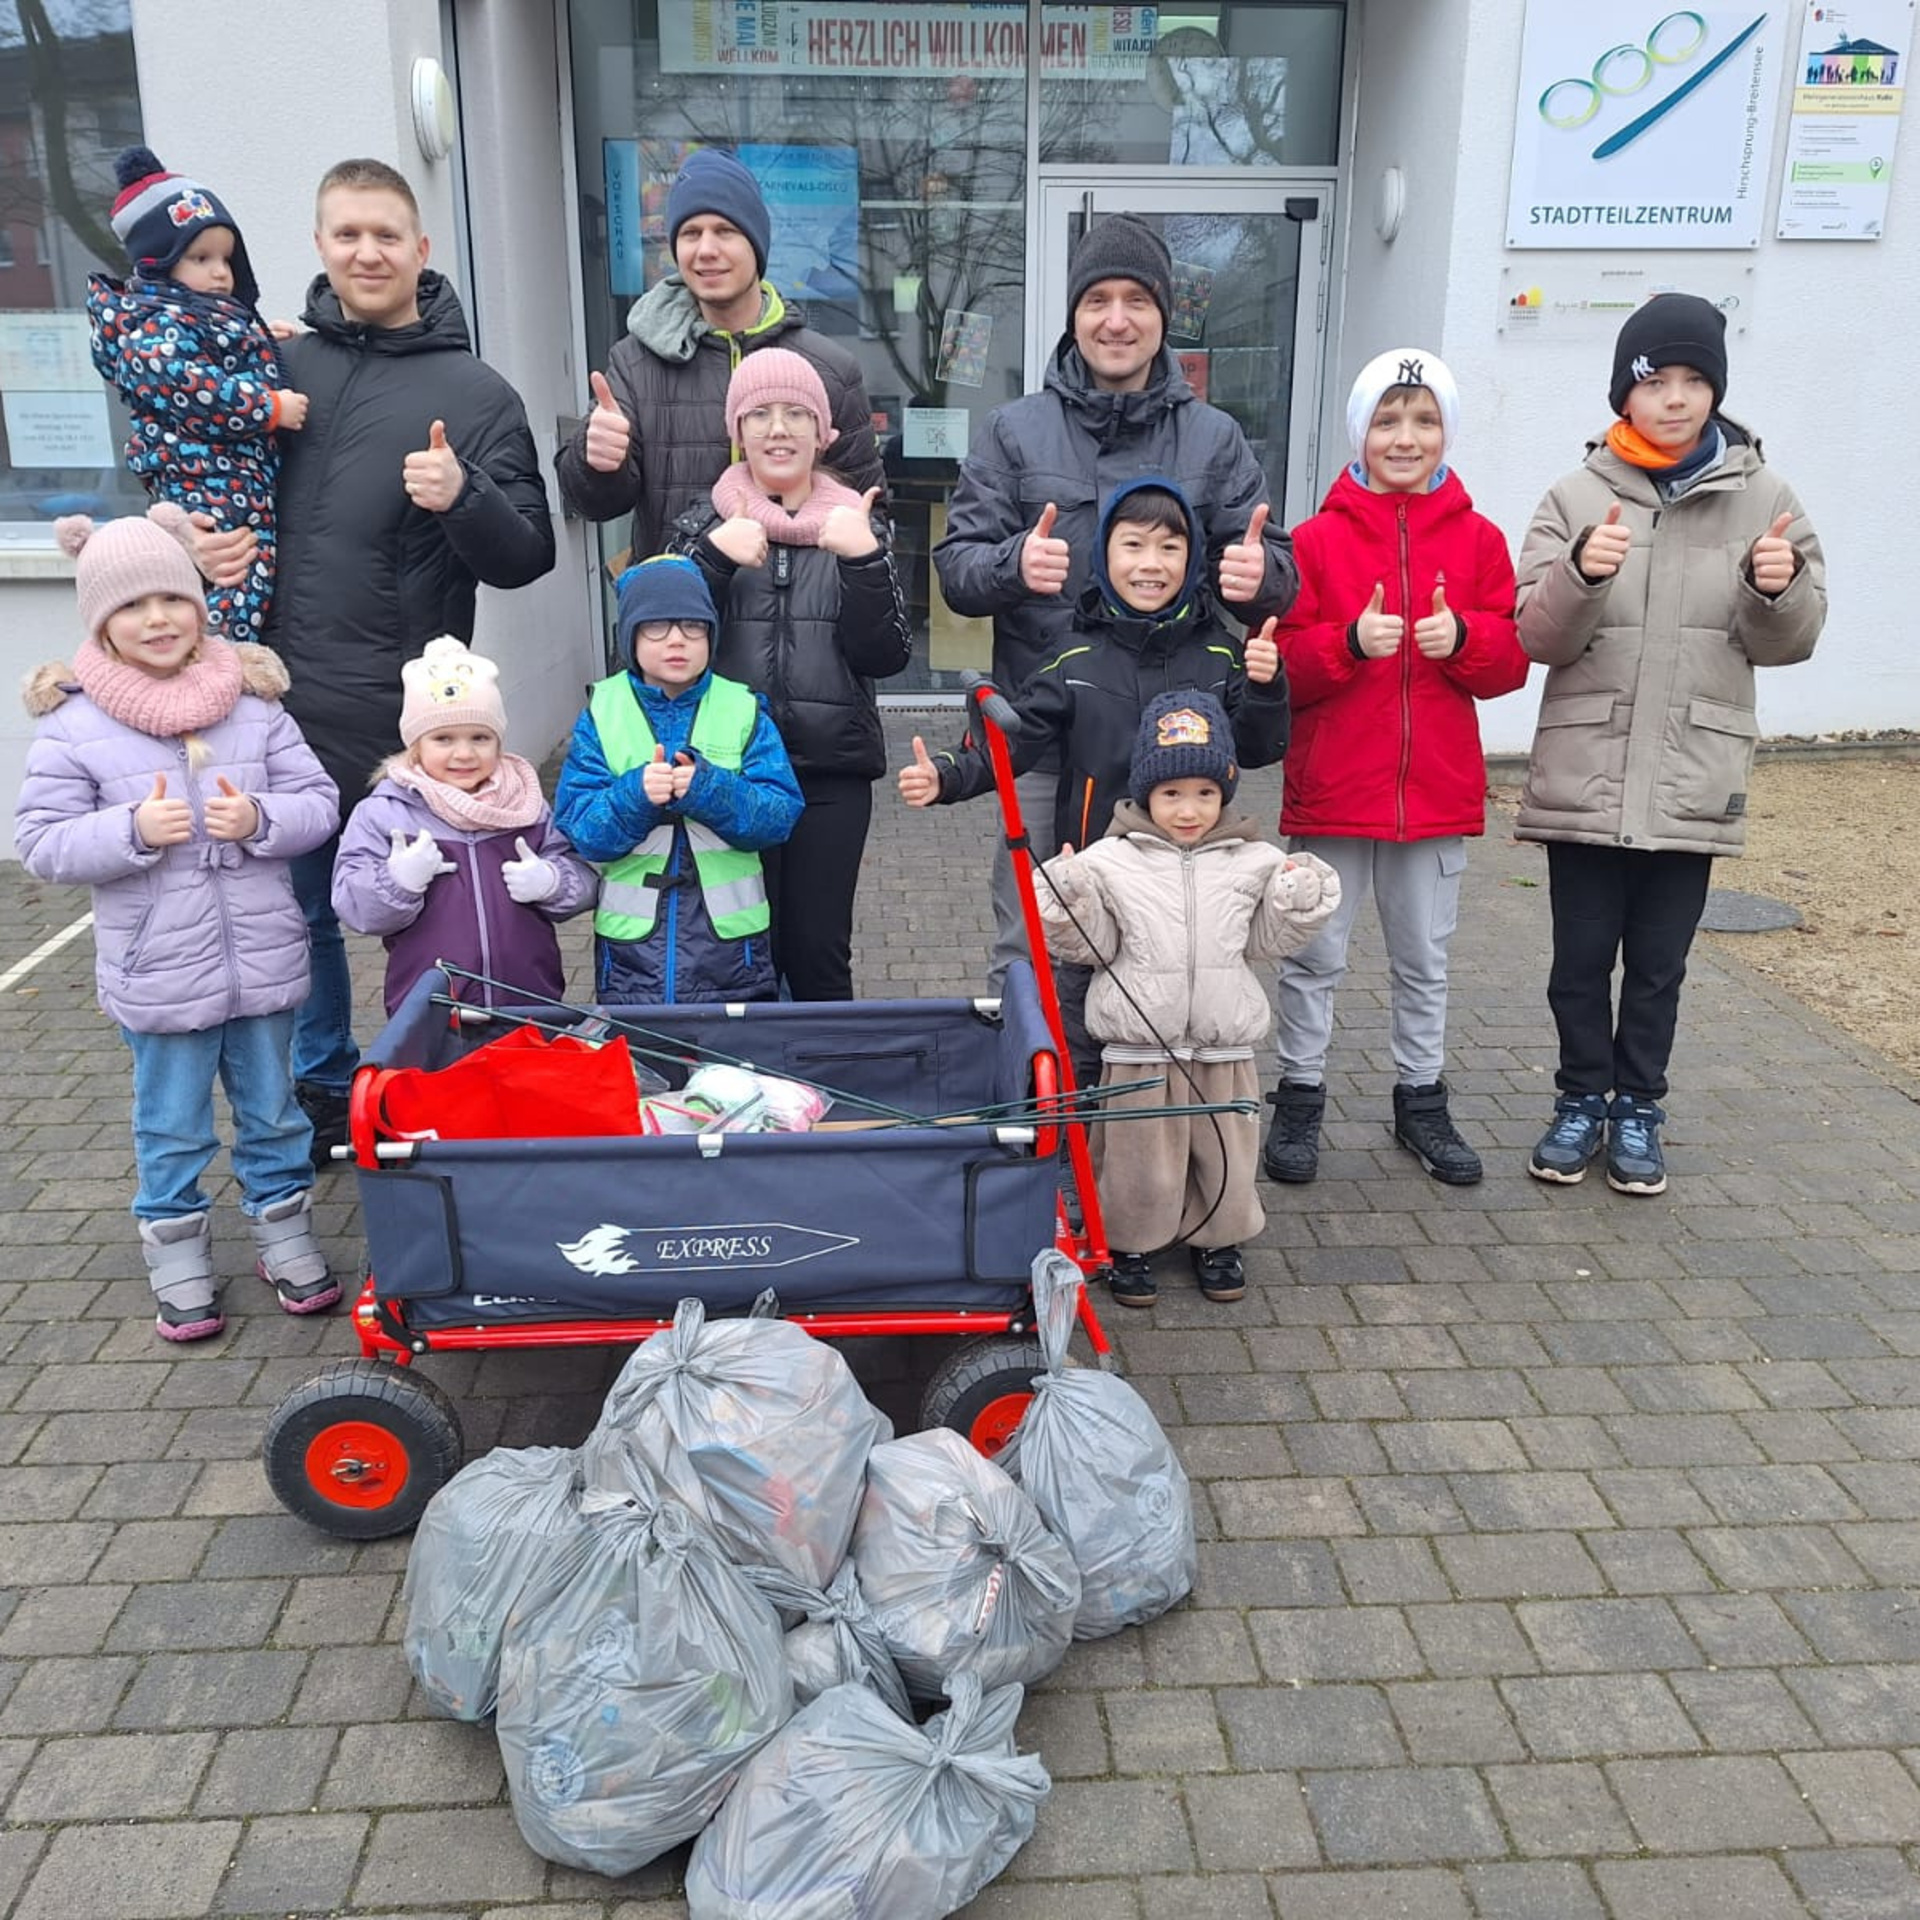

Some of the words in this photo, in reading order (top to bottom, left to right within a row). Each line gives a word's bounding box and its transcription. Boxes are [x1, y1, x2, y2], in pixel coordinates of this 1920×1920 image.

[808, 19, 920, 67] HERZLICH
[1736, 46, 1764, 199] Hirschsprung-Breitensee
[1529, 206, 1733, 225] STADTTEILZENTRUM
[1397, 358, 1424, 385] NY
[656, 1235, 773, 1260] EXPRESS
